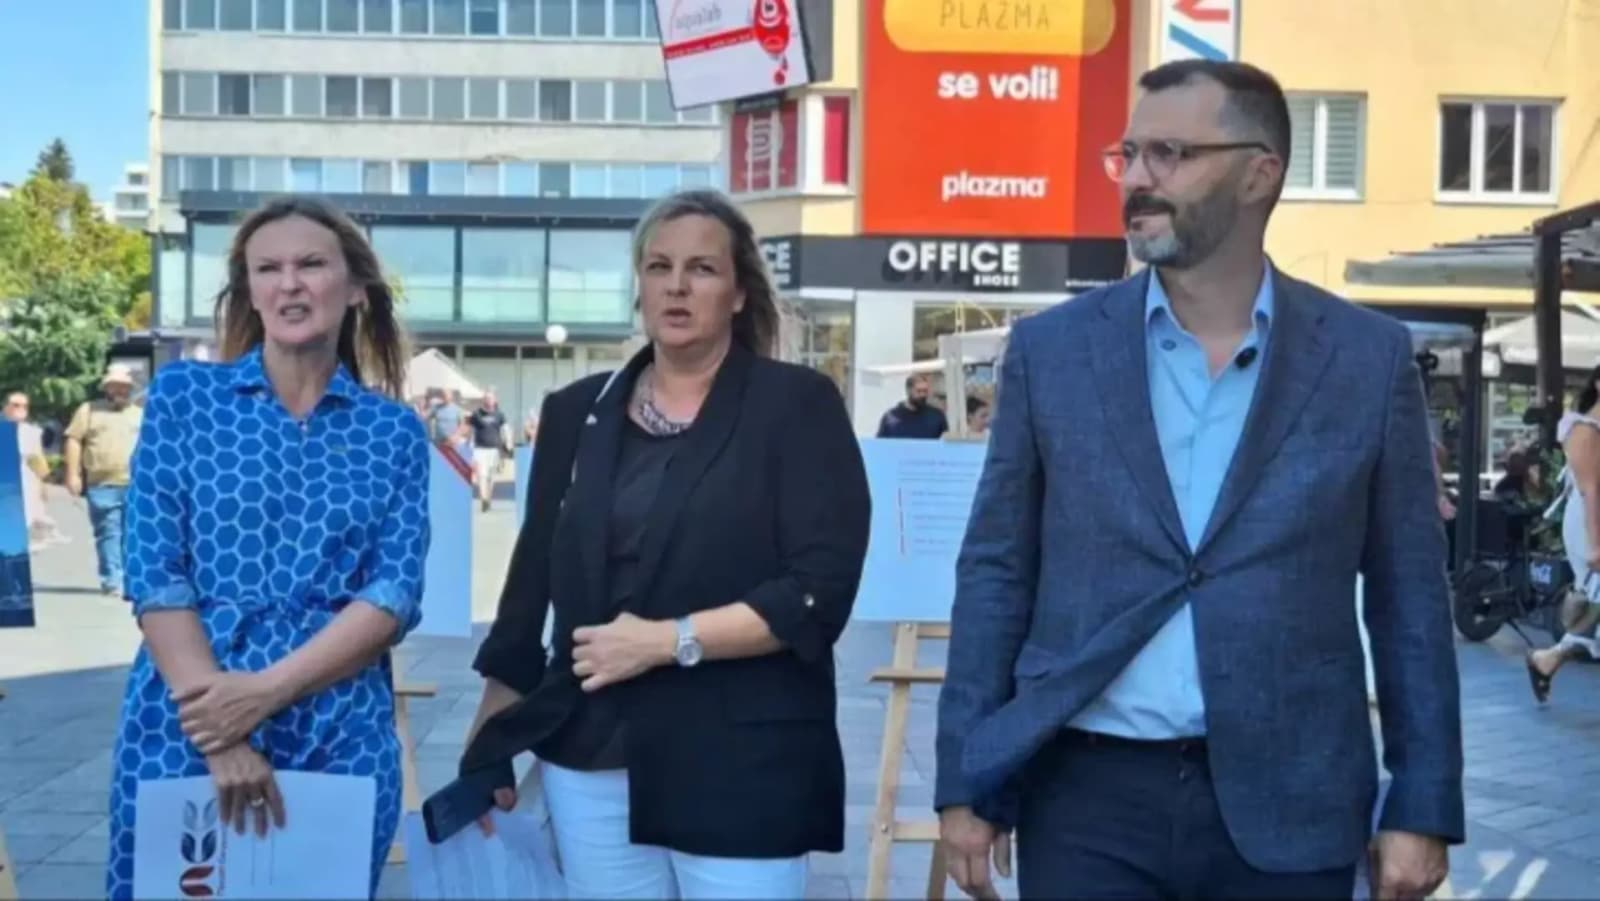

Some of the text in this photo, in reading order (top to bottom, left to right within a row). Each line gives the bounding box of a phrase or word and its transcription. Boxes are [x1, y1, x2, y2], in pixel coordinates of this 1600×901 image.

[940, 0, 1049, 30] PLAZMA
[938, 64, 1058, 100] se voli!
[942, 170, 1045, 202] plazma
[888, 241, 1020, 272] OFFICE
